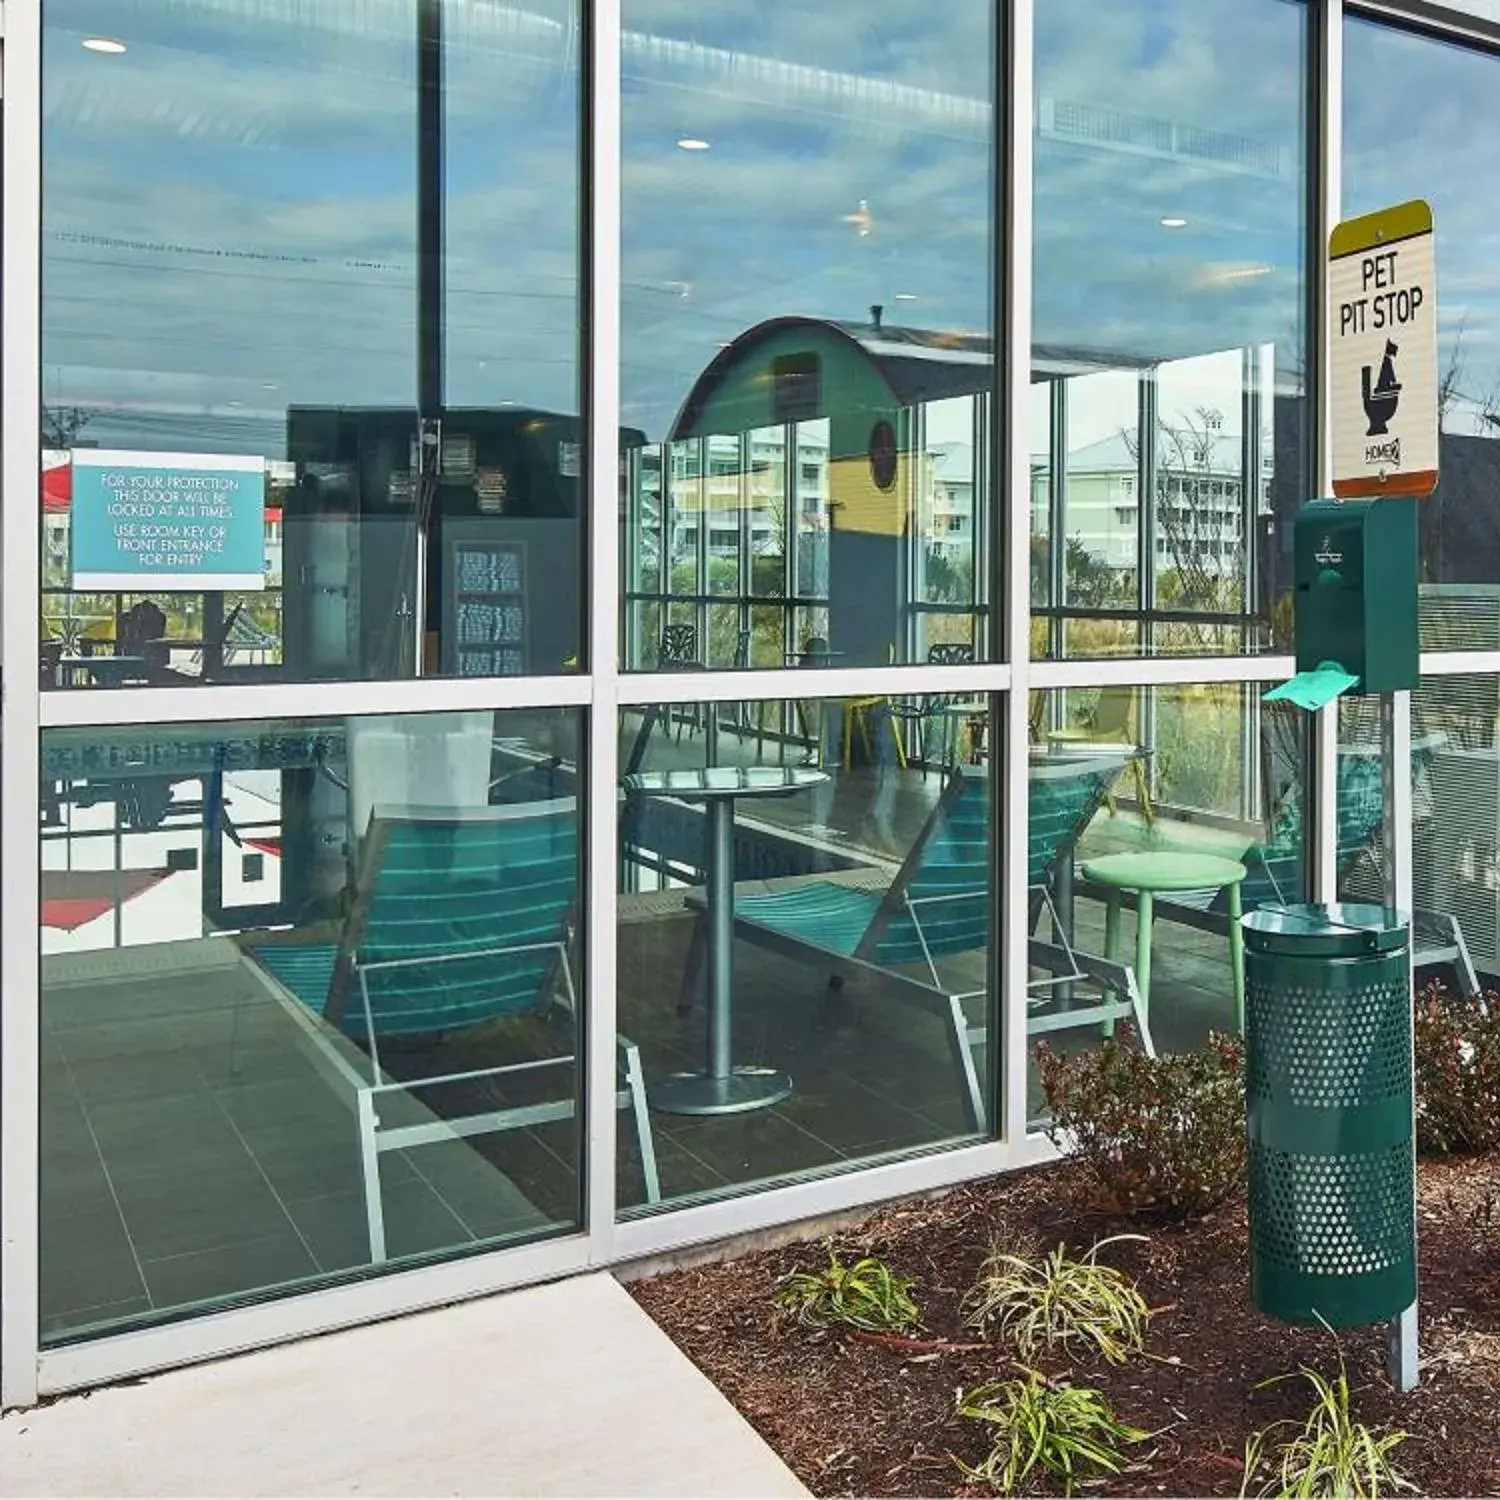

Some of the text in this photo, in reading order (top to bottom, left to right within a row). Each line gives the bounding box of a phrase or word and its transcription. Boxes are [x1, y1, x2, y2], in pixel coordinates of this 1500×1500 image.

[1362, 251, 1398, 292] PET
[1340, 286, 1423, 337] PIT STOP
[100, 473, 239, 491] FOR YOUR PROTECTION
[113, 489, 228, 505] THIS DOOR WILL BE
[107, 503, 233, 518] LOCKED AT ALL TIMES
[113, 523, 227, 539] USE ROOM KEY OR
[117, 538, 224, 553] FRONT ENTRANCE
[139, 553, 203, 566] FOR ENTRY
